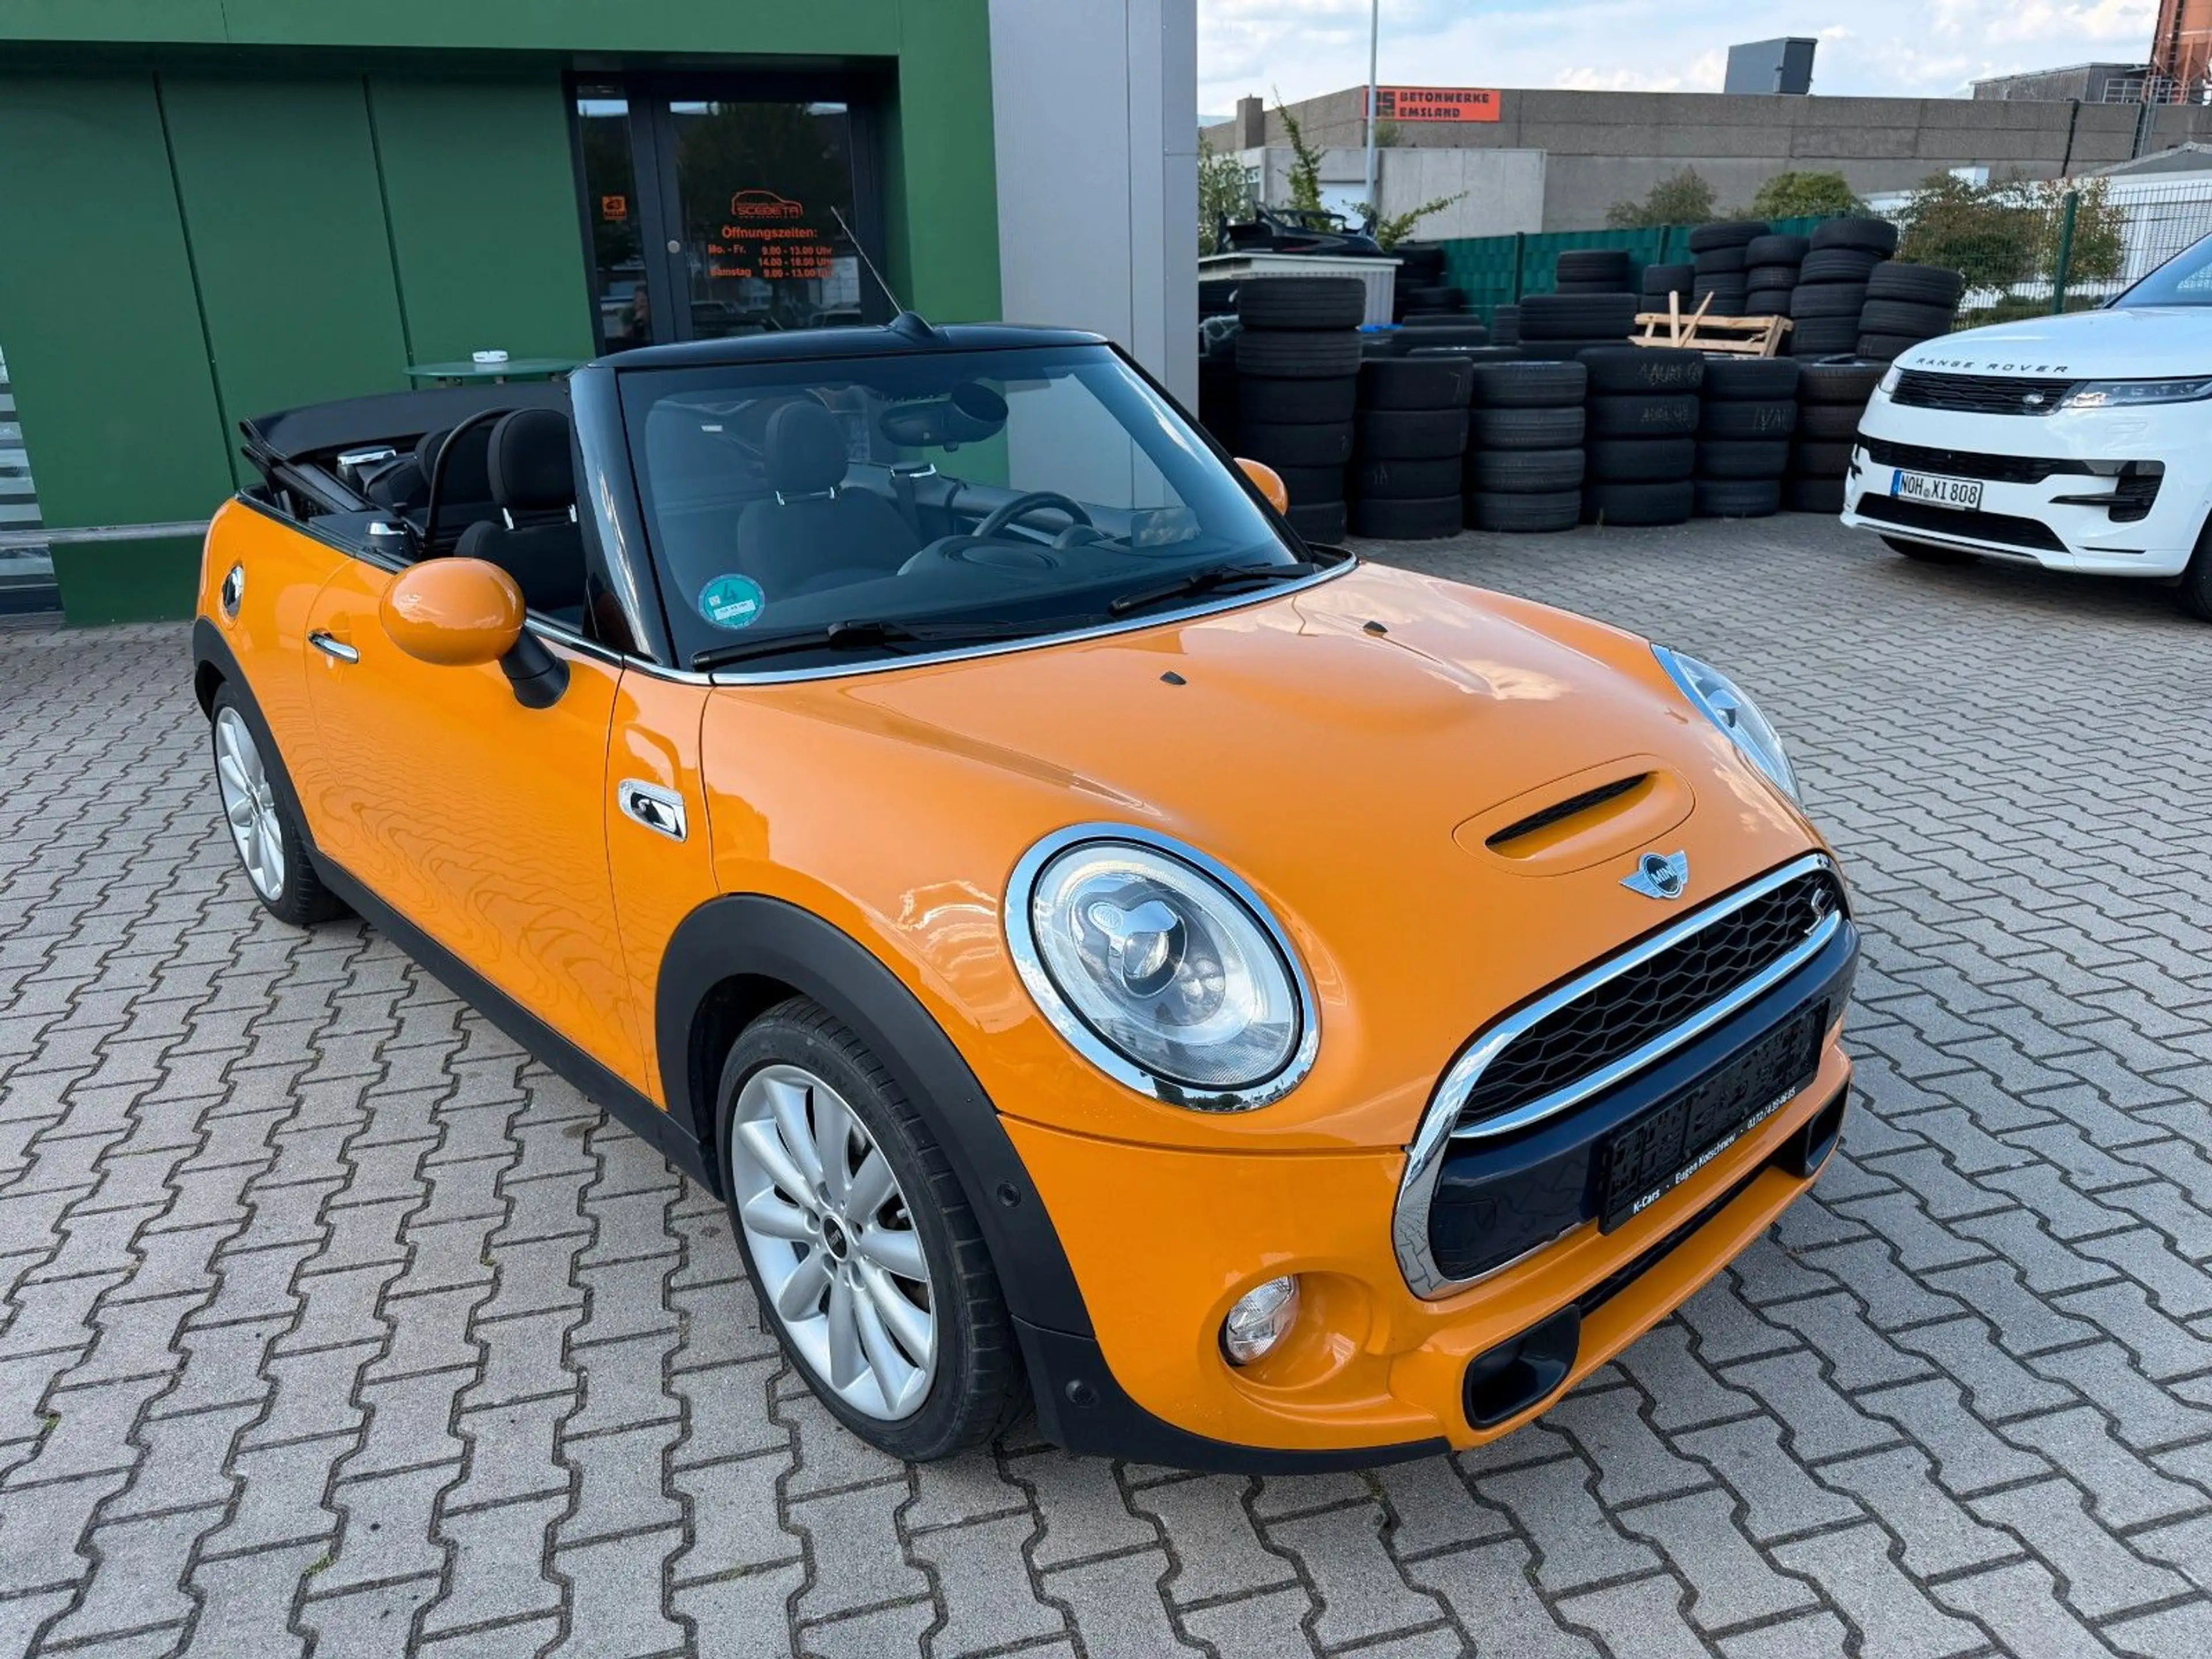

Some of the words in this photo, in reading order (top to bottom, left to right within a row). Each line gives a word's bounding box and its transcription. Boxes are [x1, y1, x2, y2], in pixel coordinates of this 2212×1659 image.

[1400, 91, 1489, 104] BETONWERKE
[1400, 107, 1461, 118] EMSLAND
[722, 224, 817, 240] Öffnungszeiten:
[709, 267, 751, 277] Samstag
[1916, 357, 1974, 369] RANGE
[1986, 363, 2069, 373] ROVER
[1900, 474, 1924, 495] NOH
[1930, 479, 1946, 499] XI
[1950, 482, 1979, 505] 808
[1650, 865, 1678, 884] MINI
[1633, 1188, 1660, 1214] K-Cars
[1675, 1160, 1698, 1184] Eugen
